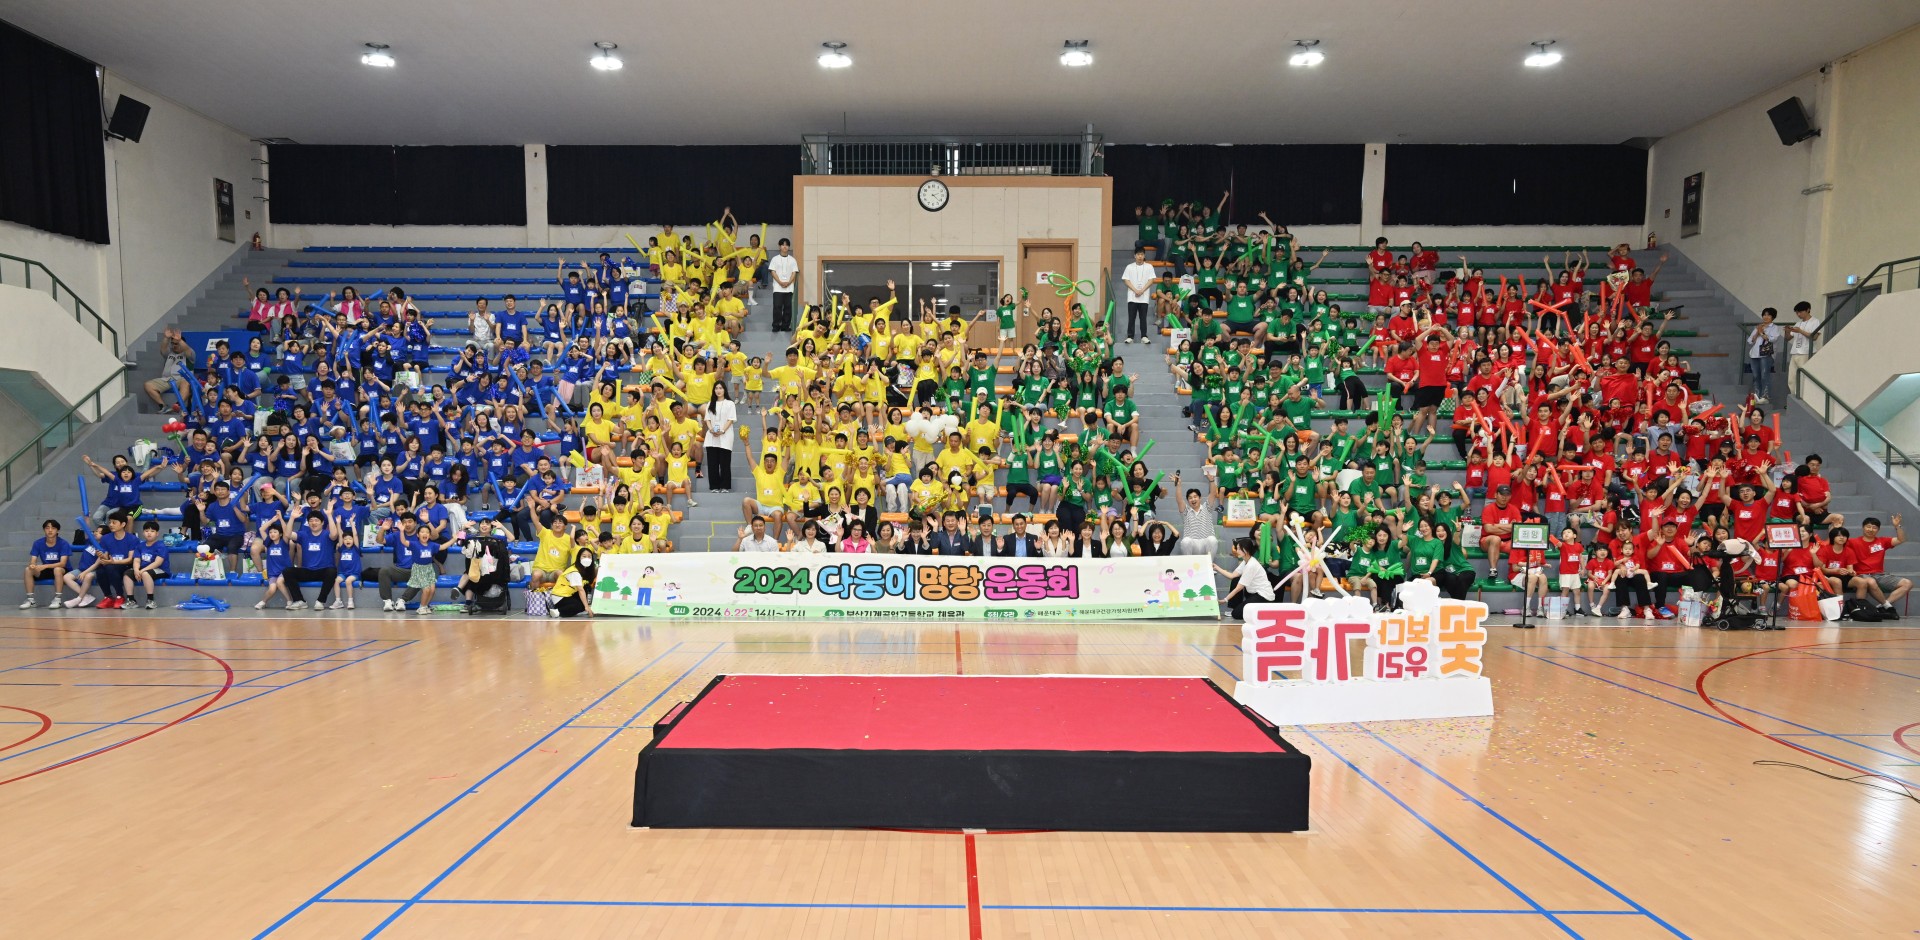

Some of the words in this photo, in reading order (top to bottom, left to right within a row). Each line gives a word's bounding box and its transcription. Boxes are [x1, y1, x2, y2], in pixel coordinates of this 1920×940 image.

[733, 566, 812, 594] 2024
[817, 563, 916, 600] 다둥이
[918, 564, 983, 601] 명랑
[983, 564, 1080, 600] 운동회
